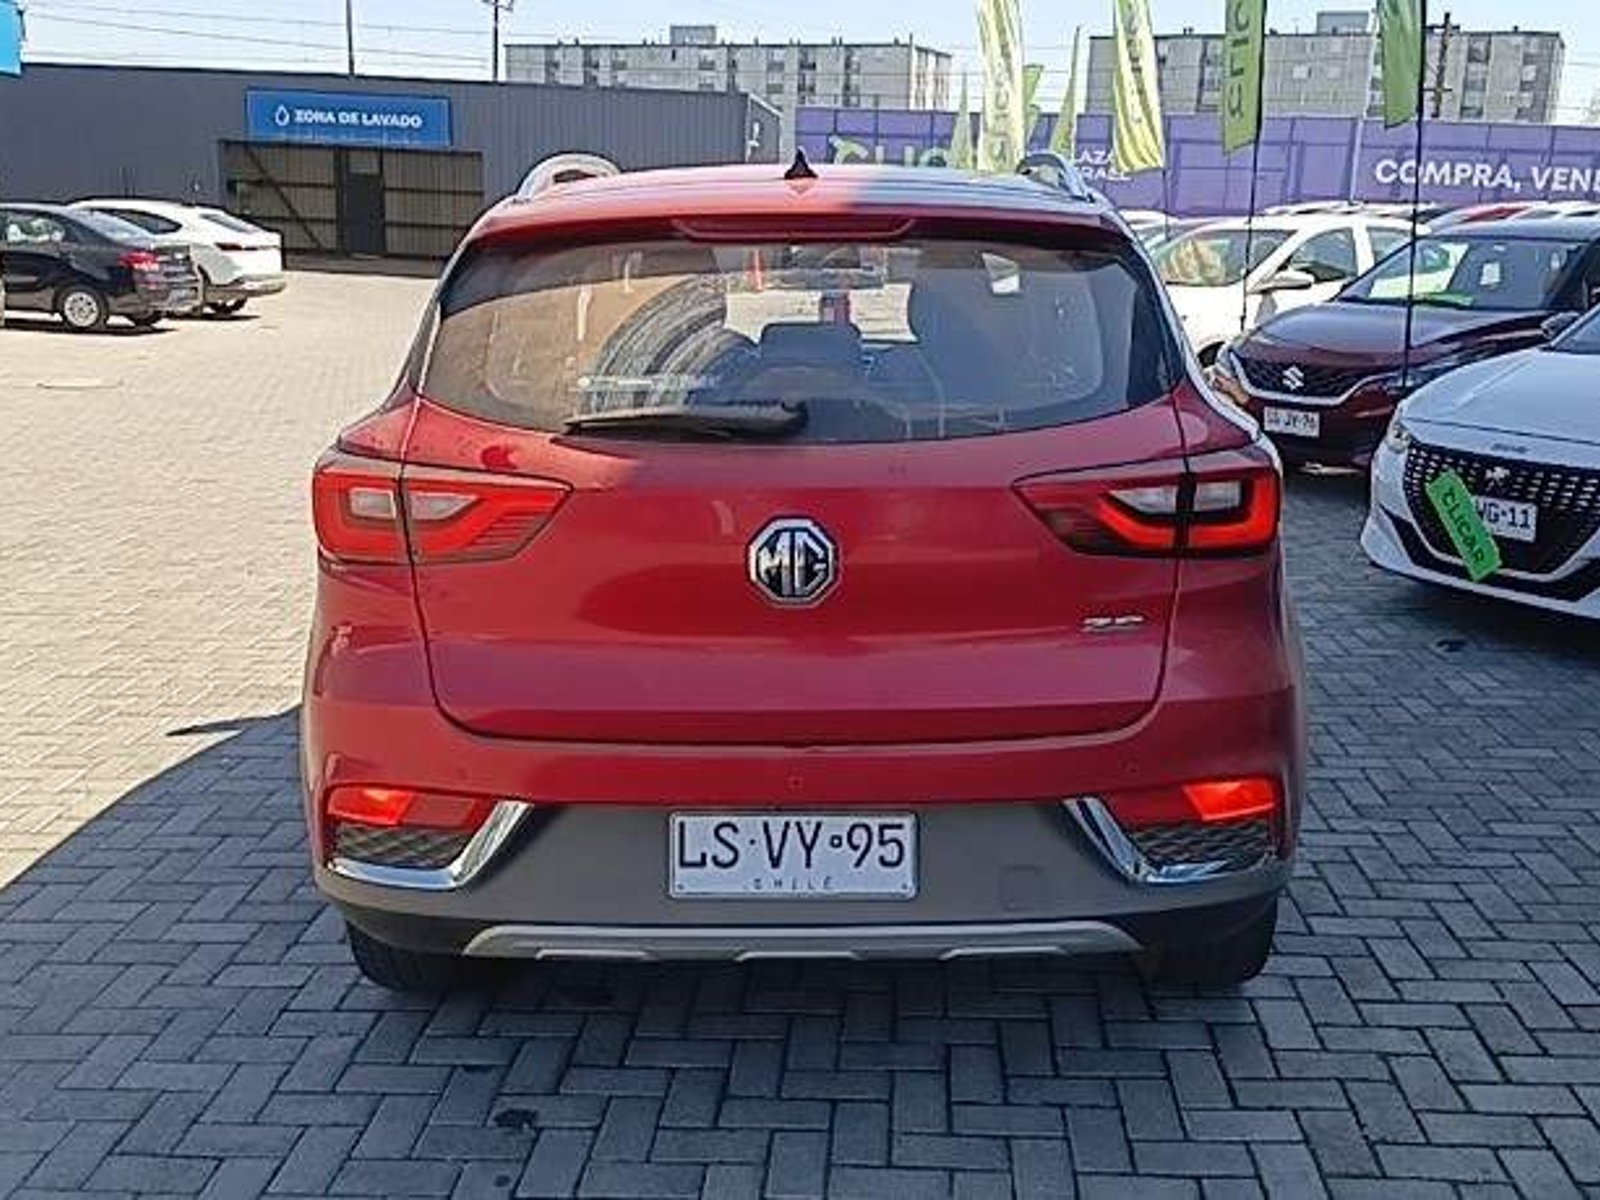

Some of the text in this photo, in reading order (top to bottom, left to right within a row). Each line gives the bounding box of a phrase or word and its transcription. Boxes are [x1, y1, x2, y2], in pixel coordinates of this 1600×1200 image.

[294, 108, 423, 129] ZONA DE LAVADO
[1375, 158, 1522, 195] COMPRA,
[1441, 487, 1485, 565] CLICAR
[758, 531, 827, 596] MG
[753, 875, 832, 891] CHILE
